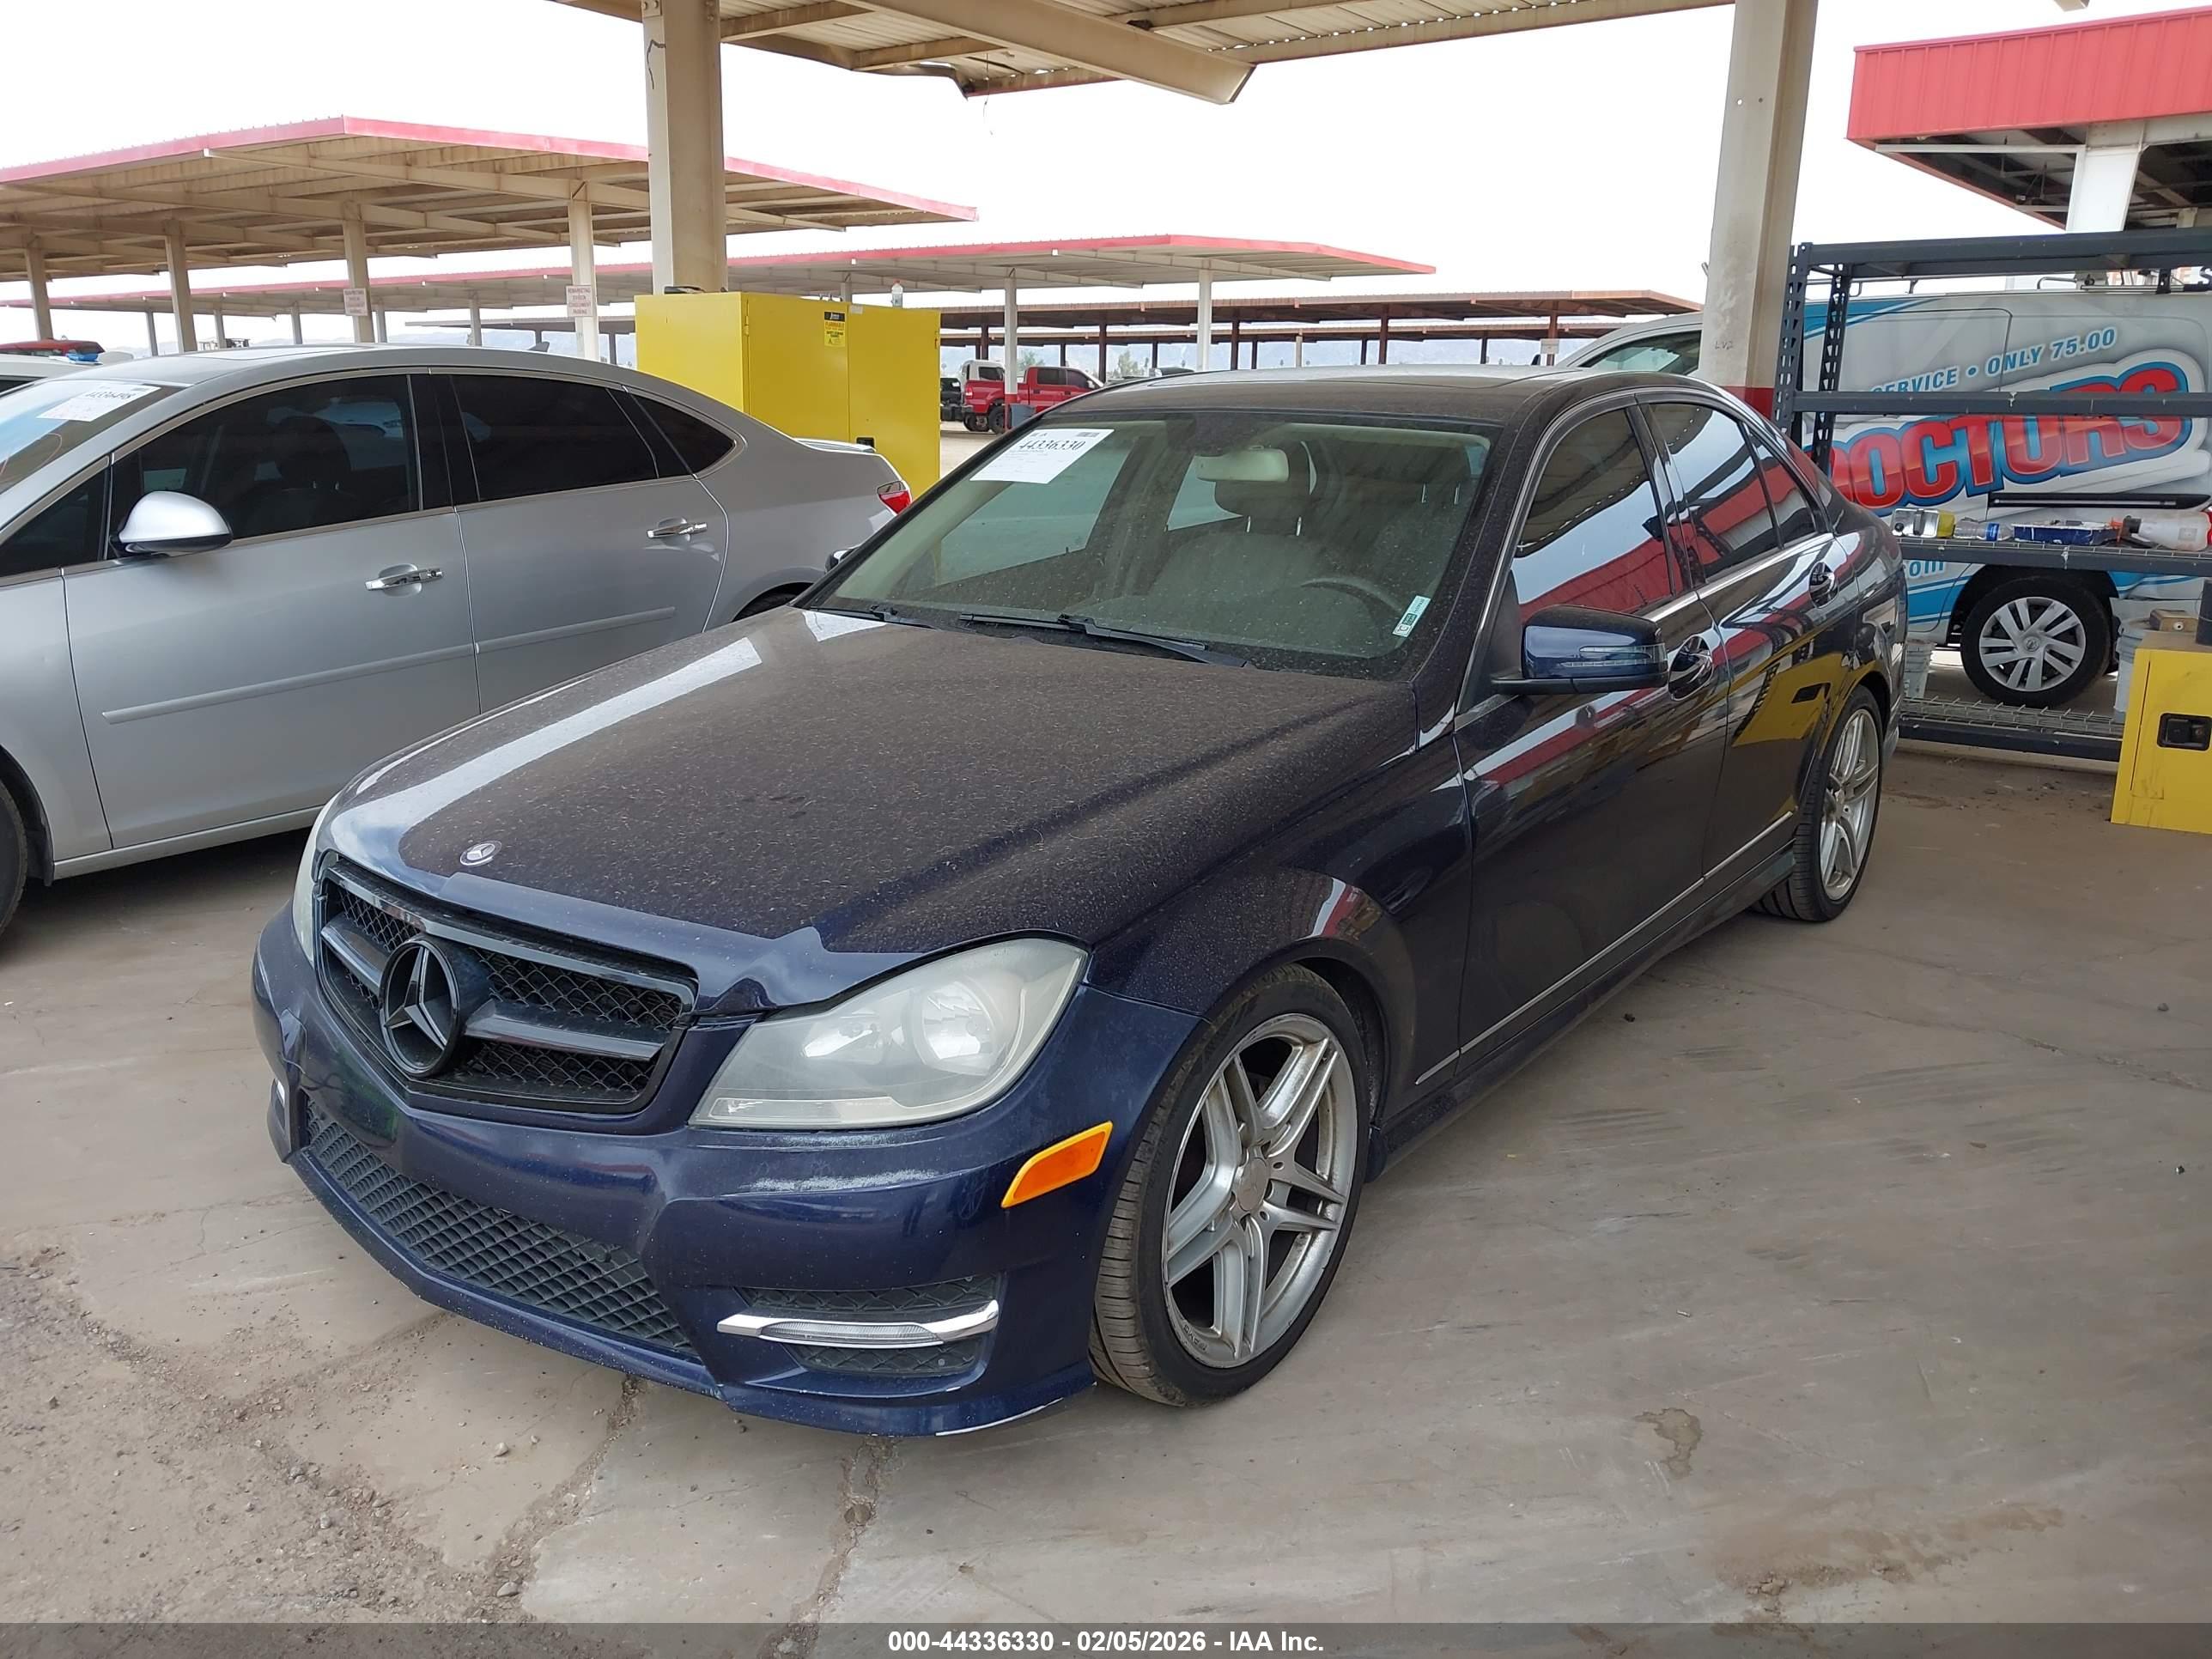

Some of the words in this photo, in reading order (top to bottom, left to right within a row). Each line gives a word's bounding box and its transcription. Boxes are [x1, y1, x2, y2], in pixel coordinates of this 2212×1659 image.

[1872, 368, 1958, 392] RVICE
[1987, 346, 2043, 375] ONLY
[2051, 329, 2115, 359] 75.00
[1019, 440, 1086, 451] 44336330
